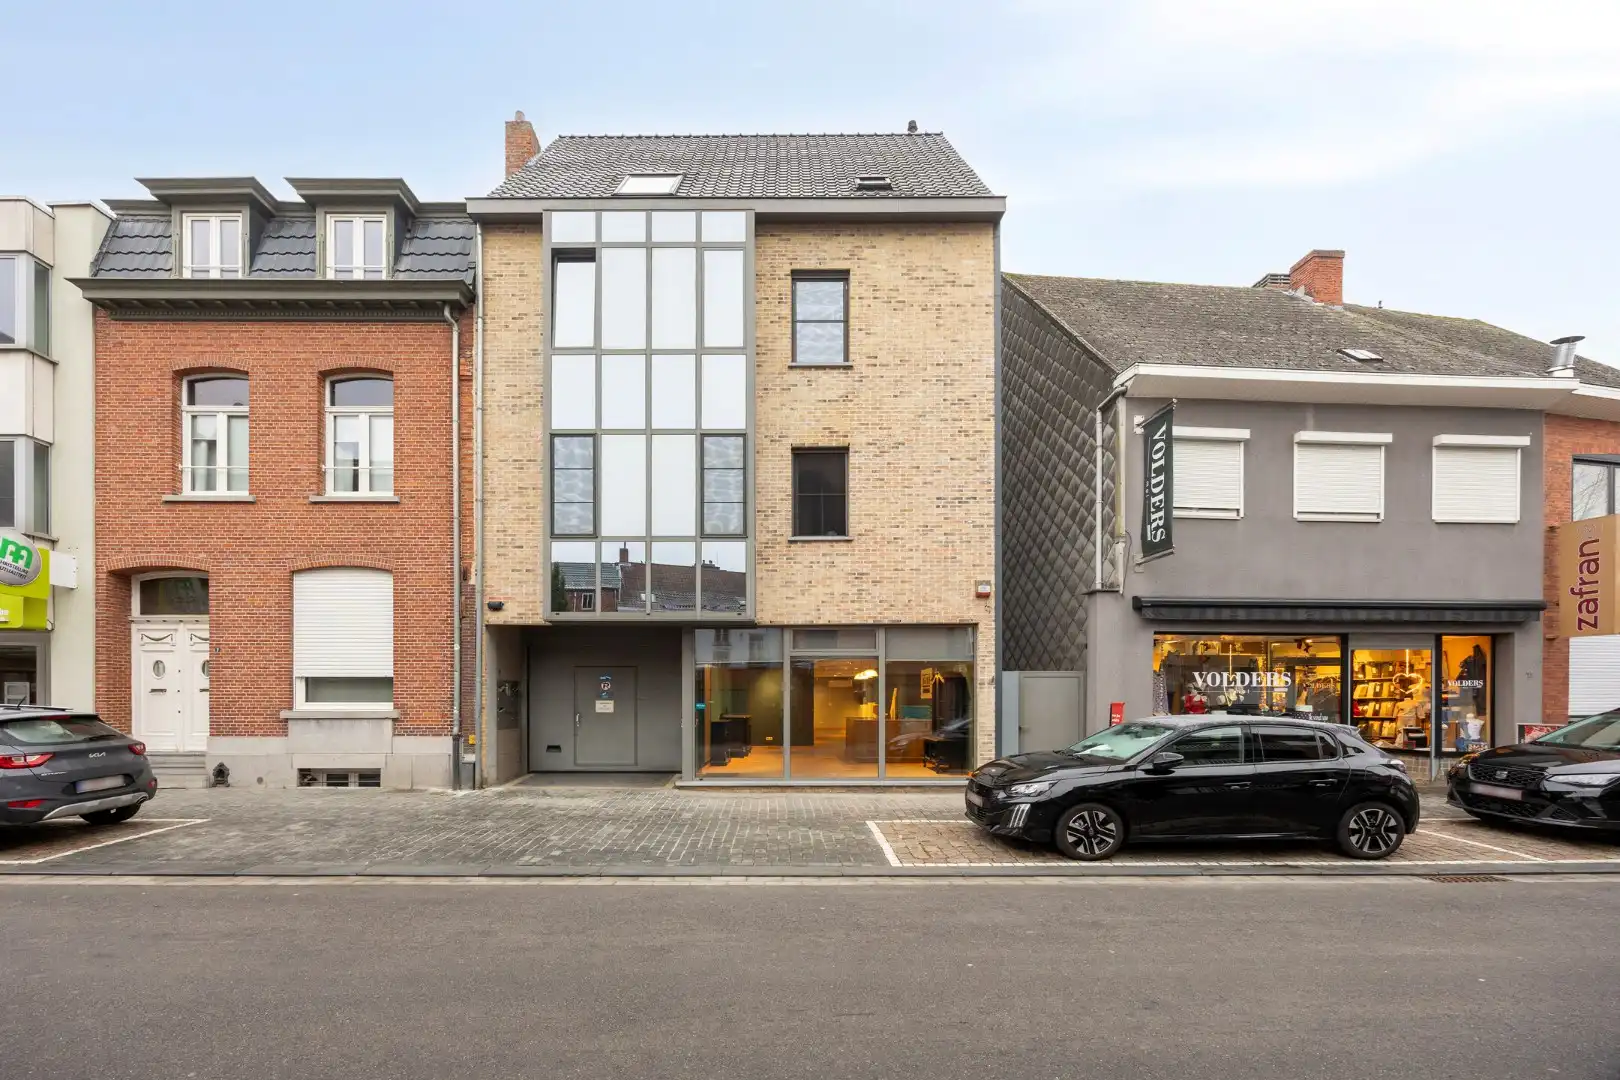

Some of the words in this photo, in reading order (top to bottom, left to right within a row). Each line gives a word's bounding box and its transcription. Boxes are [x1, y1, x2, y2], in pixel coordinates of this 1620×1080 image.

[1151, 421, 1167, 543] VOLDERS
[1569, 538, 1599, 631] zafran
[1192, 671, 1292, 687] VOLDERS
[1447, 679, 1484, 687] VOLDERS
